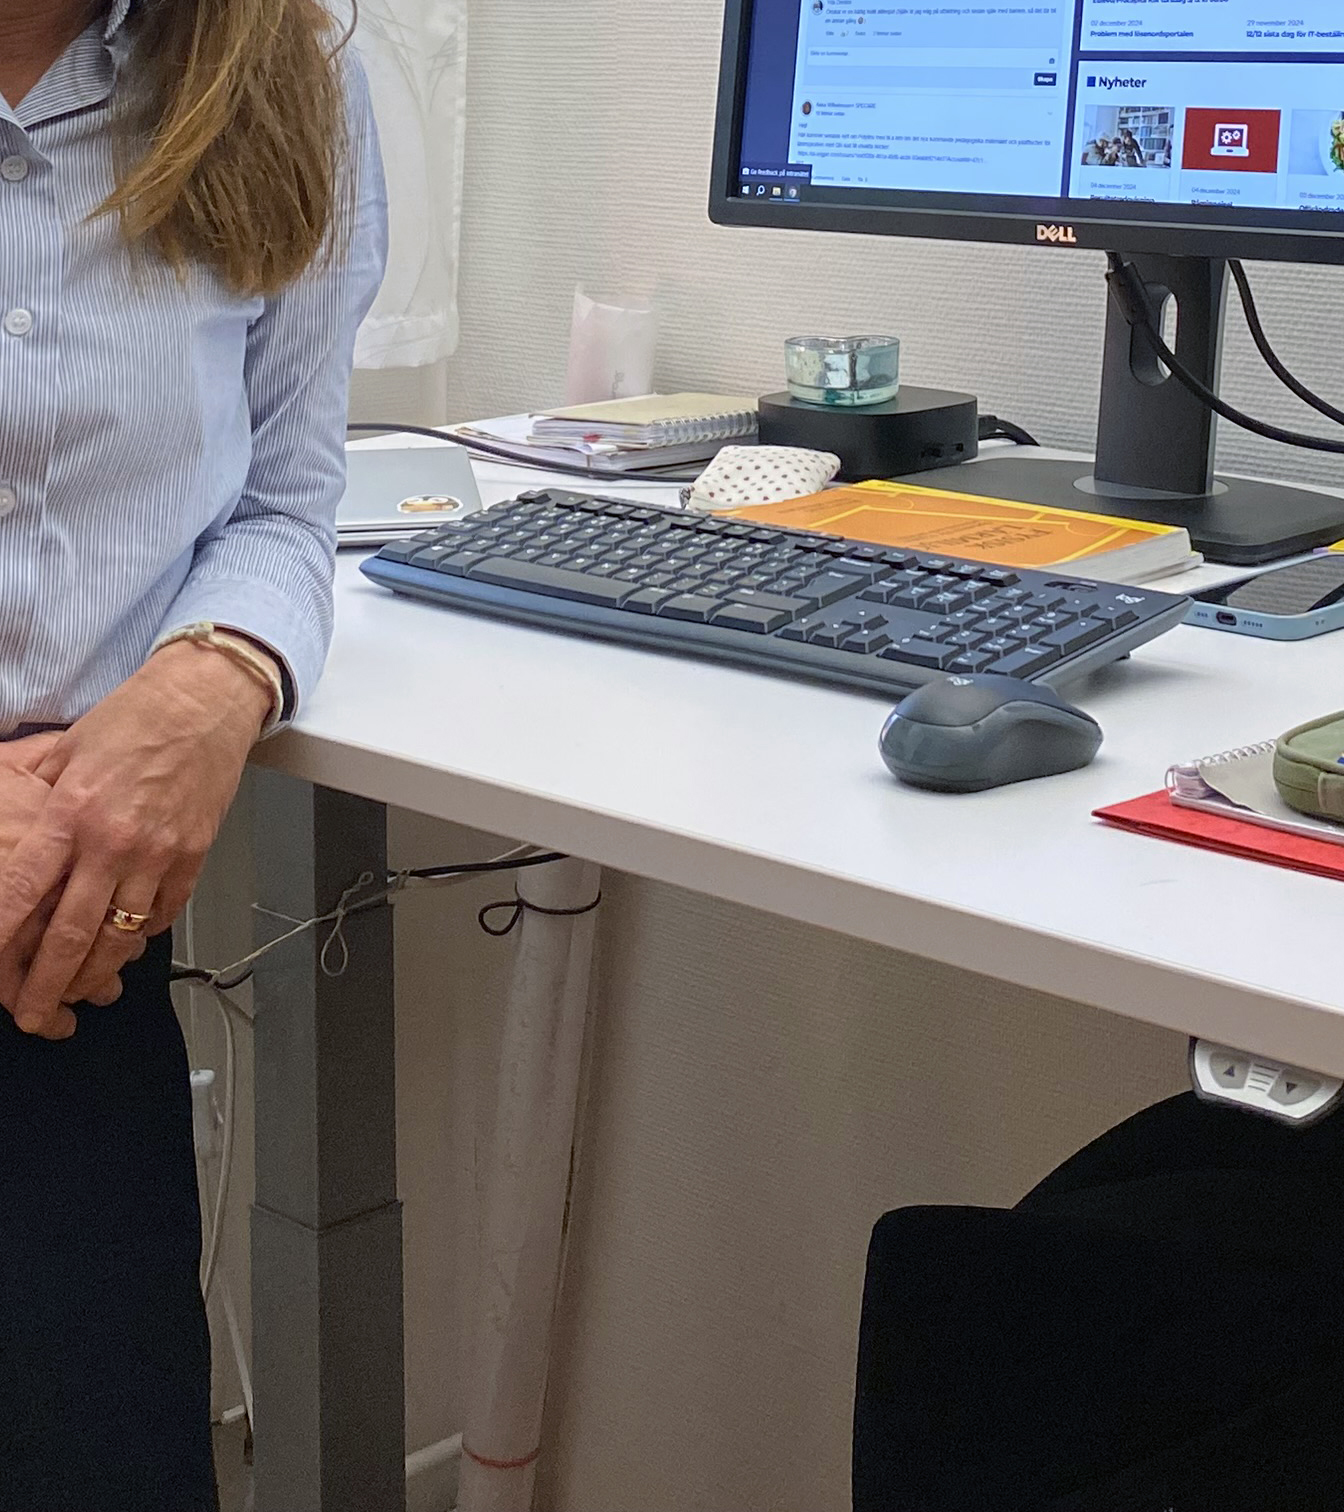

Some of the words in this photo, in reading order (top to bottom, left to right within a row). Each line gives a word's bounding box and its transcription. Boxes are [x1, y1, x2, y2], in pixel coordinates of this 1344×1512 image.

[1263, 30, 1280, 38] sista
[1281, 30, 1295, 39] dag
[1296, 30, 1307, 38] för
[1098, 75, 1147, 89] Nyheter
[1036, 224, 1077, 243] DELL
